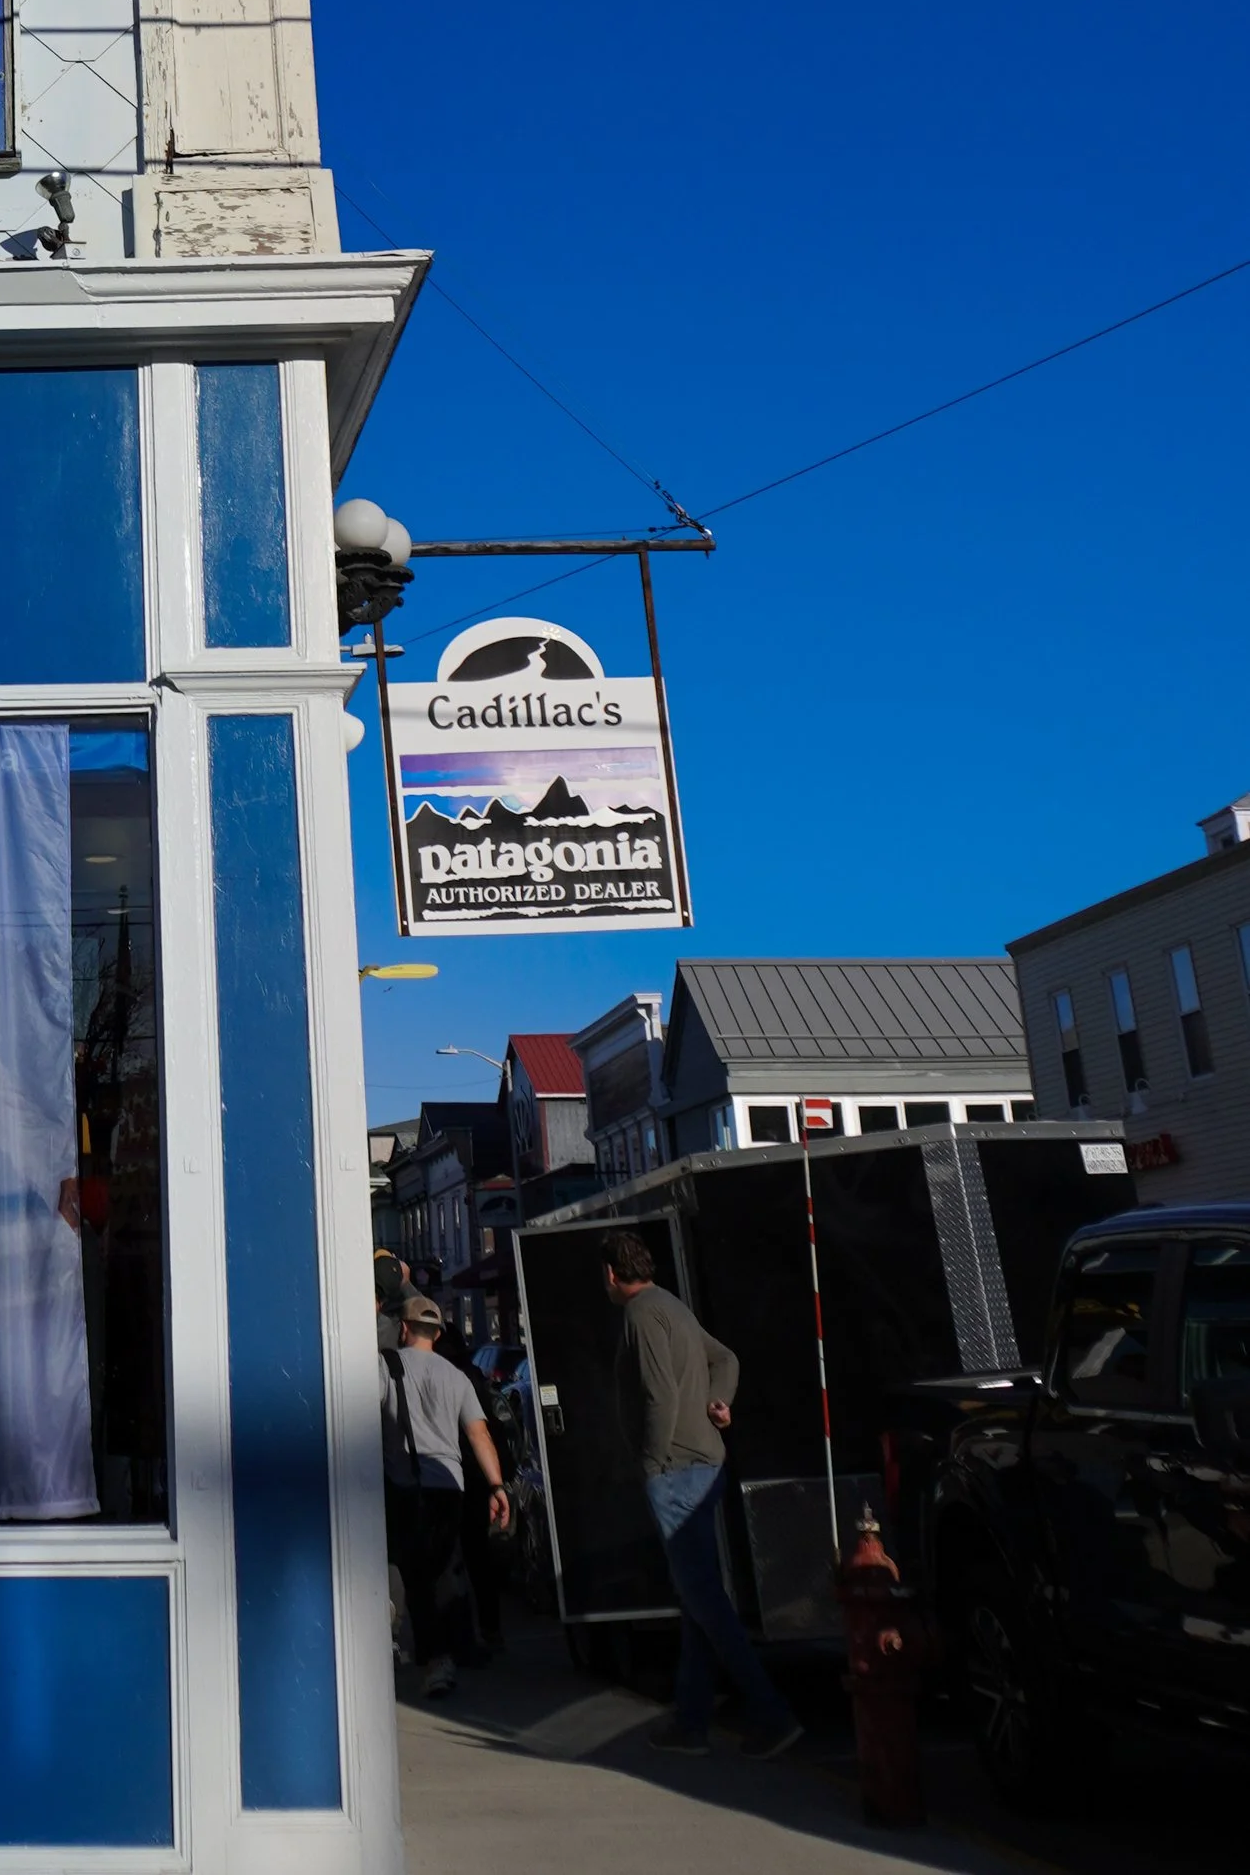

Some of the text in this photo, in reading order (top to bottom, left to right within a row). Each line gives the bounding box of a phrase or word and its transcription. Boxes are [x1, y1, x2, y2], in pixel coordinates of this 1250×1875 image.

[427, 691, 623, 730] Cadillac's
[418, 831, 663, 884] patagonia
[425, 881, 661, 905] AUTHORIZED DEALER
